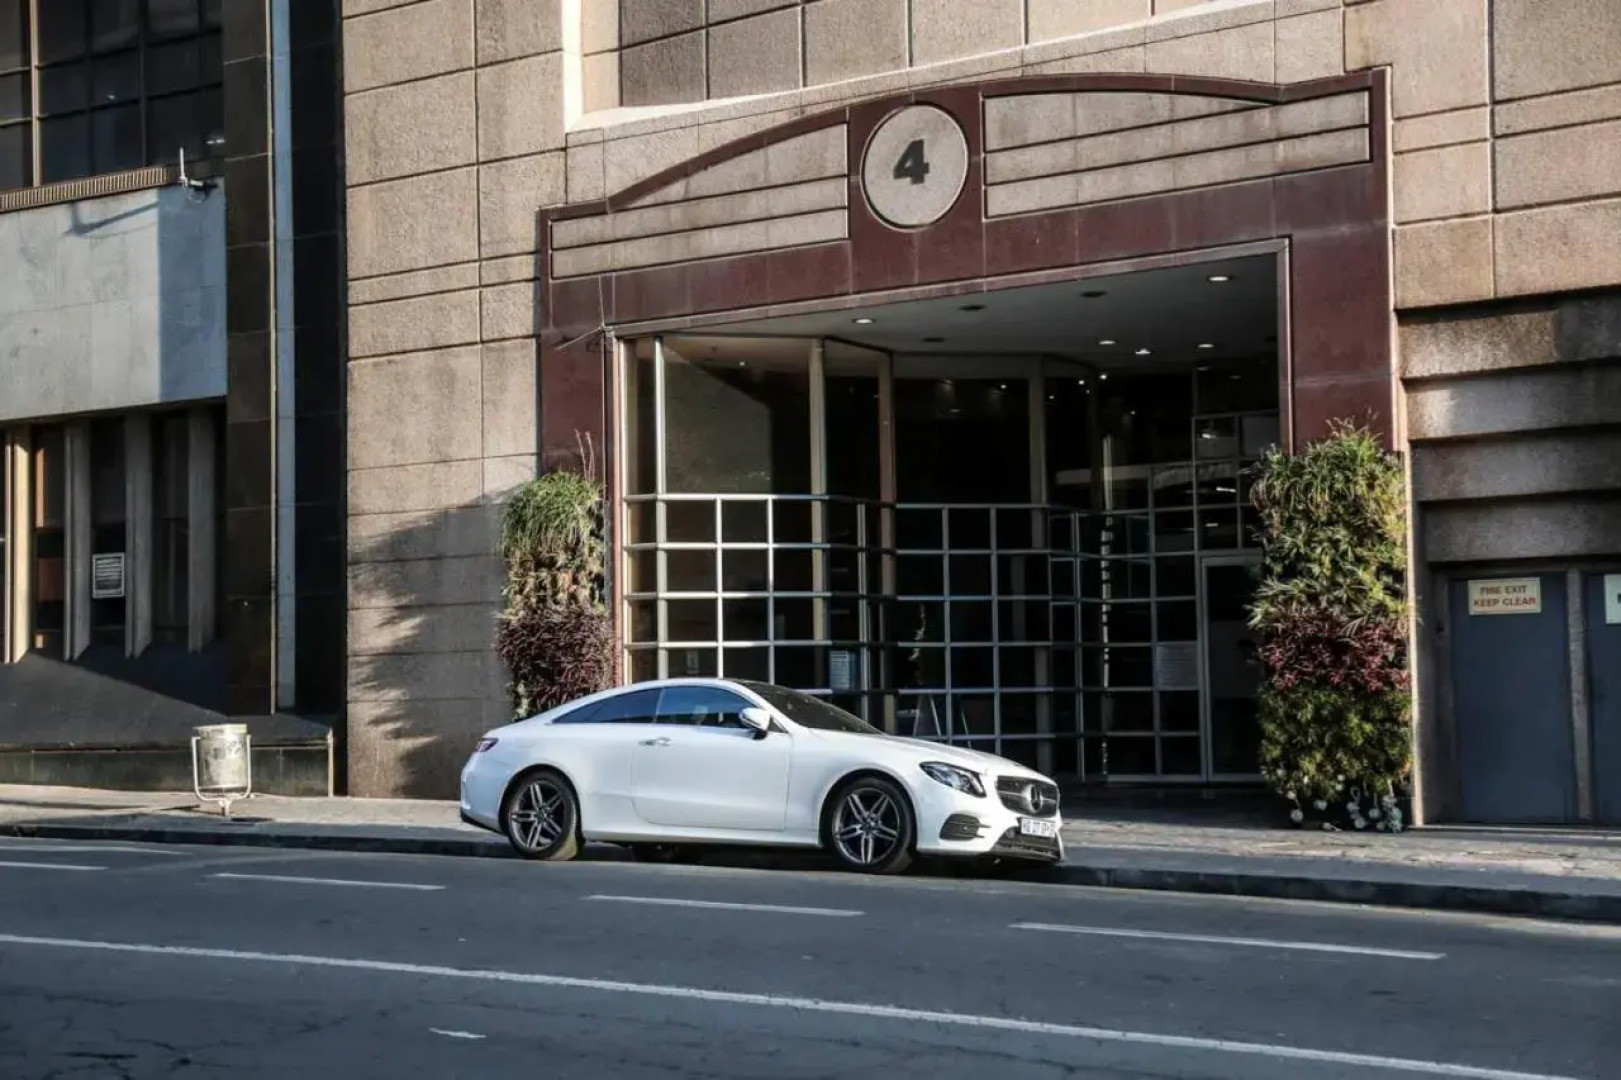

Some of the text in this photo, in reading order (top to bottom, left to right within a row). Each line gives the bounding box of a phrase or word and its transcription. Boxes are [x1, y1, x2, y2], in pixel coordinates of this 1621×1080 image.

[893, 138, 930, 185] 4
[1480, 585, 1527, 595] FIRE EXIT
[1473, 597, 1536, 607] KEEP CLEAR
